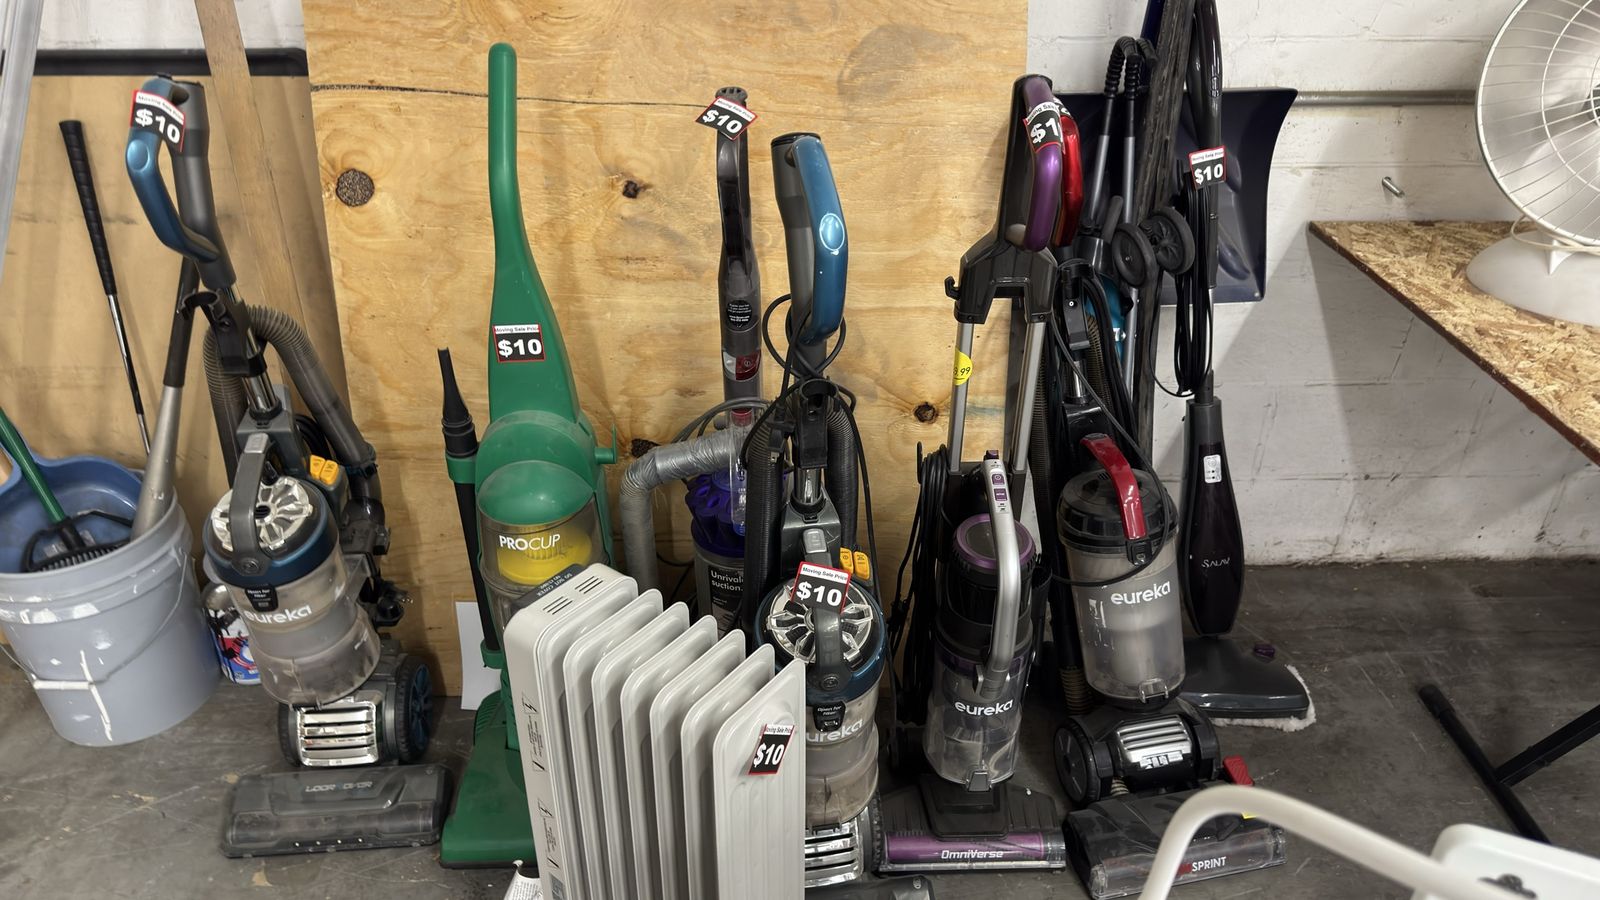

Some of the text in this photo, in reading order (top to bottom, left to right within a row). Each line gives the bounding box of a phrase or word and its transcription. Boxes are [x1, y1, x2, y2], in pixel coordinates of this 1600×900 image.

[135, 108, 180, 144] $10
[702, 109, 743, 134] $10
[1194, 163, 1224, 185] $10
[497, 338, 543, 358] $10
[499, 533, 560, 551] PROCUP
[802, 567, 822, 576] Moving
[712, 580, 744, 591] suction.
[796, 581, 842, 607] $10
[1110, 581, 1171, 605] eureka
[243, 604, 312, 624] eureka
[955, 699, 1014, 716] eureka
[806, 718, 863, 742] ureka
[753, 742, 785, 768] $10
[941, 849, 1004, 859] OmniVerse
[1191, 856, 1227, 872] SPRINT
